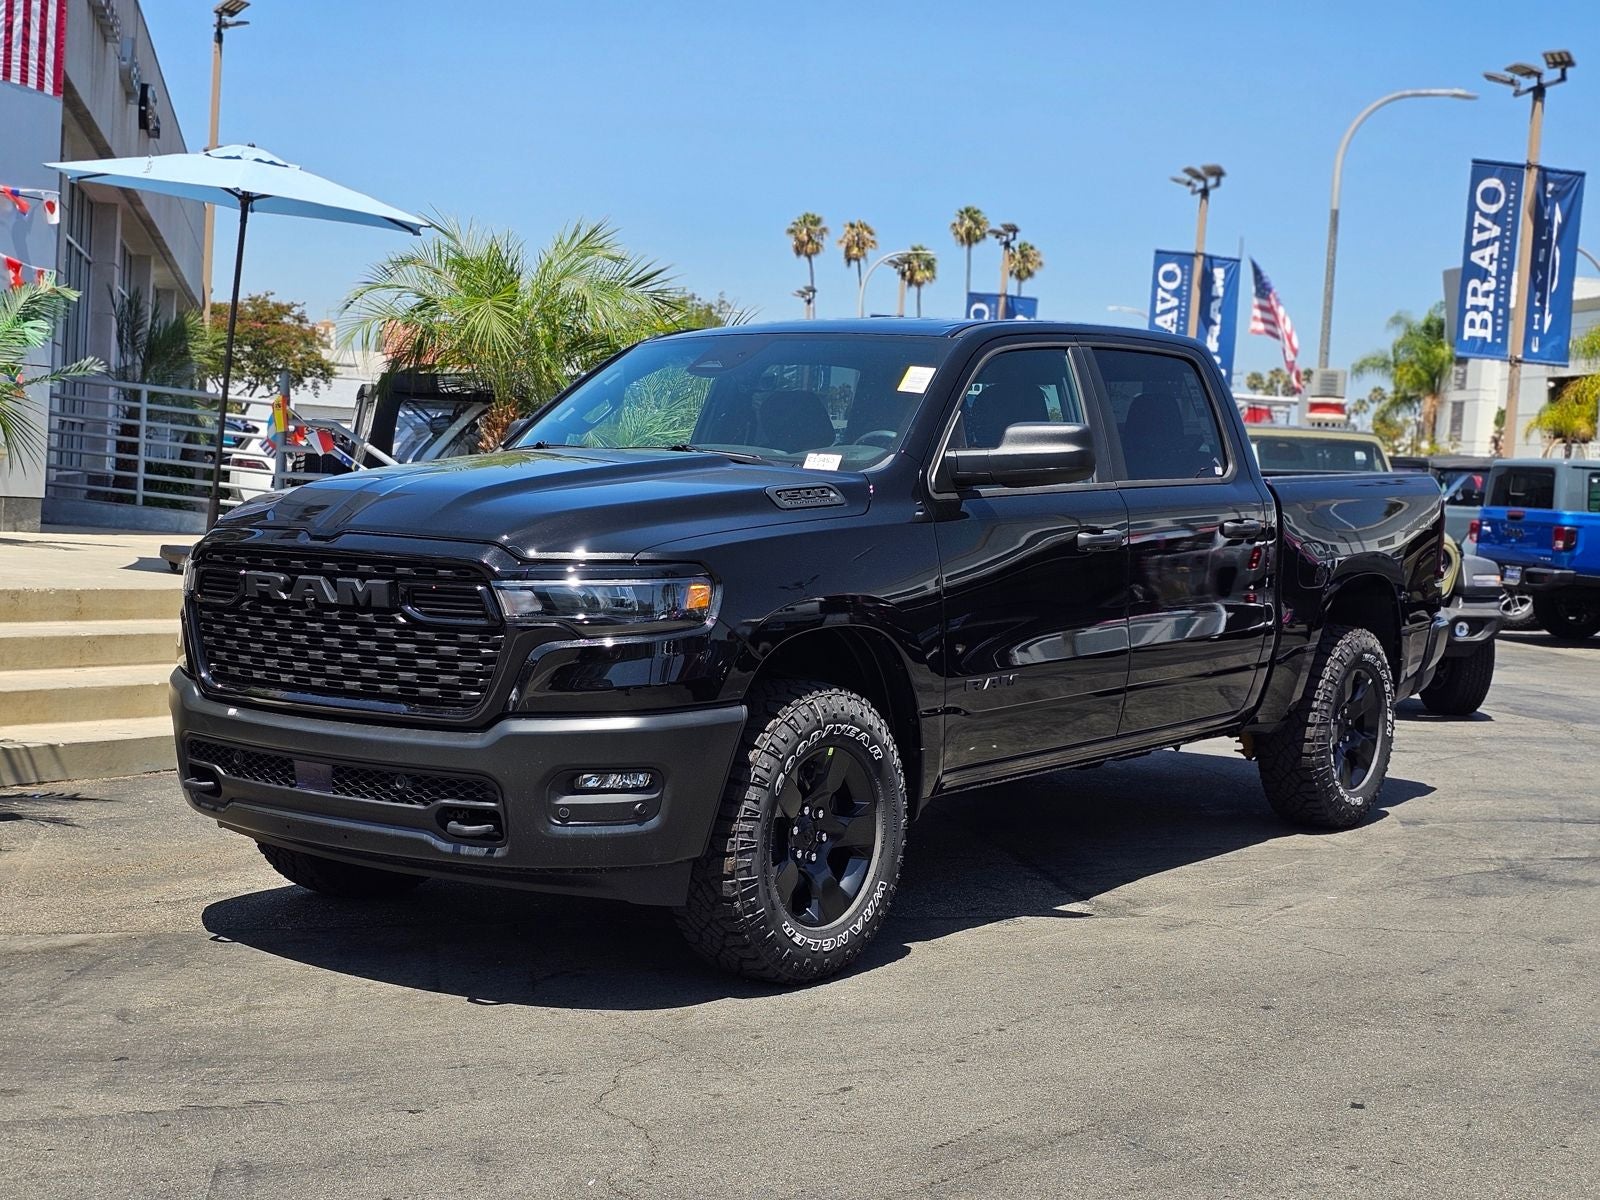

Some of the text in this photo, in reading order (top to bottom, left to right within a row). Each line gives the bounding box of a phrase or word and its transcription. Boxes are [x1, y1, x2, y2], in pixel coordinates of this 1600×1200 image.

[1463, 177, 1506, 343] BRAVO
[1496, 309, 1504, 332] NEW
[1502, 257, 1508, 270] OF
[1531, 182, 1555, 353] CHRYSLER
[1154, 262, 1182, 334] AVO
[1206, 267, 1225, 352] RAM
[777, 488, 830, 500] 1500
[245, 569, 395, 608] RAM
[775, 722, 883, 796] GOODYEAR
[781, 880, 887, 954] WRANGLER
